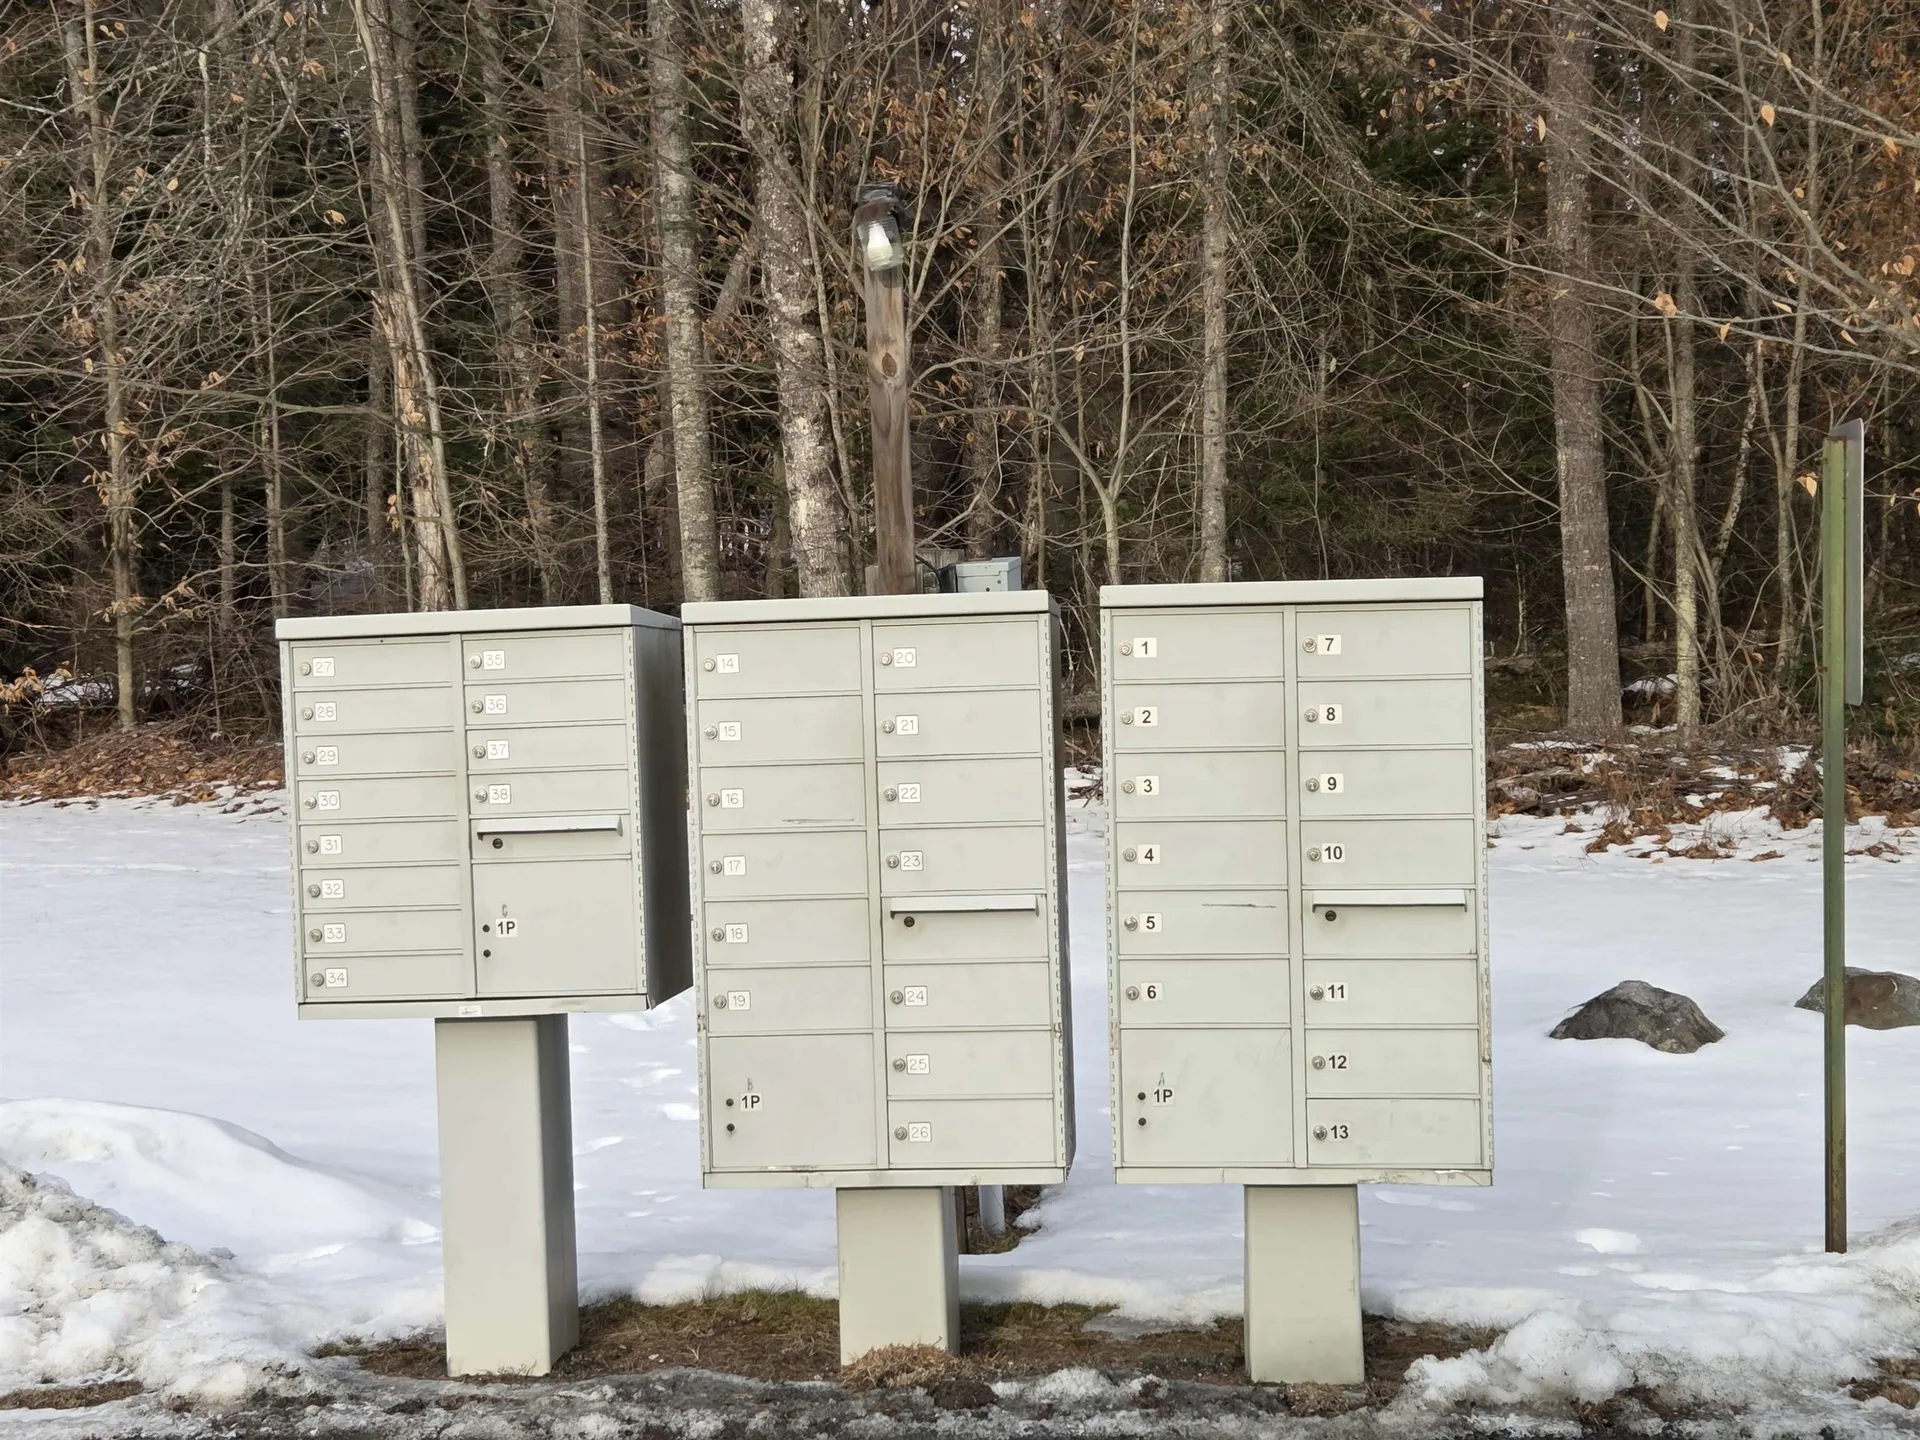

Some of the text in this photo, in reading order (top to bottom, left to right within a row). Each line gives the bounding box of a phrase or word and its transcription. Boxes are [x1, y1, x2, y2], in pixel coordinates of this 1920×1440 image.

[1141, 641, 1149, 655] 1
[1324, 638, 1334, 652] 7
[485, 653, 503, 666] 35
[895, 650, 914, 664] 20
[315, 661, 332, 674] 27
[720, 658, 734, 670] 14
[487, 698, 505, 711] 36
[317, 705, 335, 719] 28
[1142, 710, 1152, 724] 2
[1326, 707, 1336, 721] 8
[723, 725, 736, 737] 15
[899, 718, 915, 732] 21
[318, 749, 337, 762] 29
[489, 743, 508, 756] 37
[1143, 779, 1153, 793] 3
[1327, 777, 1337, 791] 9
[491, 788, 509, 801] 38
[725, 792, 739, 804] 16
[900, 786, 919, 800] 22
[320, 794, 338, 807] 30
[324, 839, 339, 852] 31
[1144, 848, 1154, 861] 4
[1324, 846, 1343, 860] 10
[727, 859, 741, 871] 17
[902, 854, 920, 868] 23
[324, 883, 342, 896] 32
[497, 920, 515, 936] 1P
[1145, 916, 1156, 930] 5
[326, 927, 344, 940] 33
[730, 927, 743, 939] 18
[327, 972, 346, 985] 34
[906, 989, 925, 1002] 24
[1146, 985, 1156, 999] 6
[1327, 985, 1346, 999] 11
[732, 994, 746, 1007] 19
[908, 1058, 927, 1071] 25
[1328, 1055, 1347, 1070] 12
[741, 1093, 761, 1109] 1P
[1153, 1088, 1174, 1104] 1P
[910, 1126, 929, 1139] 26
[1330, 1125, 1349, 1140] 13
